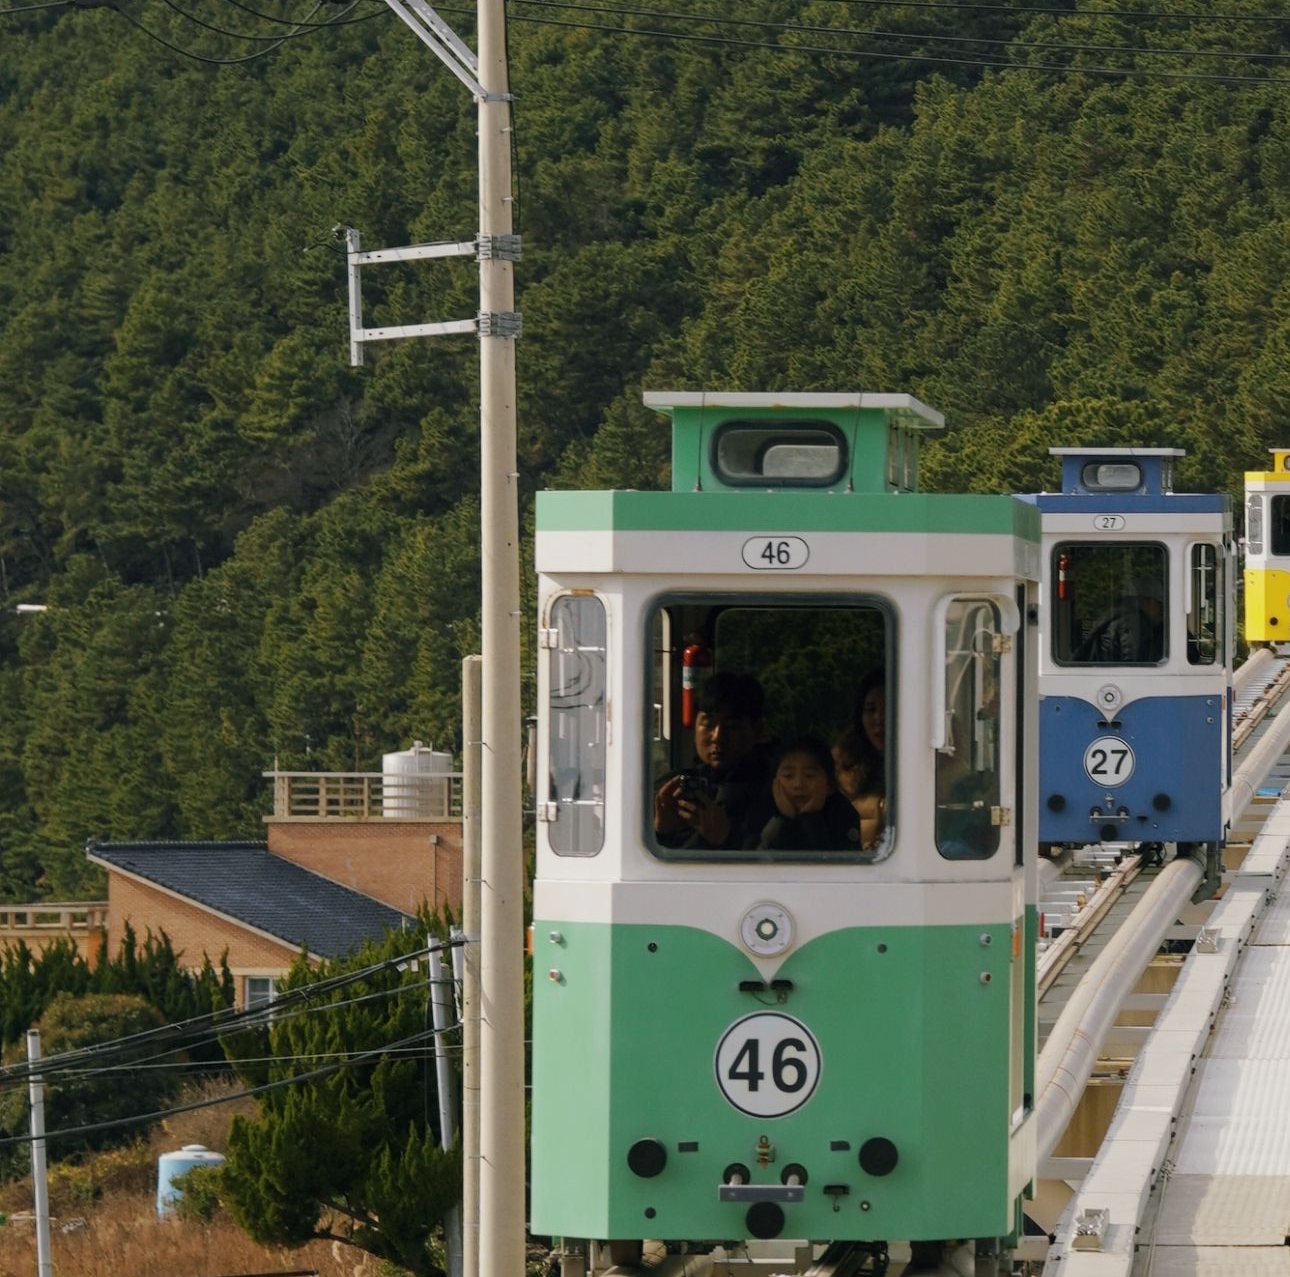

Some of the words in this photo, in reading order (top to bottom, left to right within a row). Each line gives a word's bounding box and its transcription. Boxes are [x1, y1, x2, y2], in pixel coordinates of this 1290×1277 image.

[1102, 516, 1117, 530] 27
[760, 541, 791, 565] 46
[1091, 749, 1129, 775] 27
[728, 1037, 808, 1093] 46
